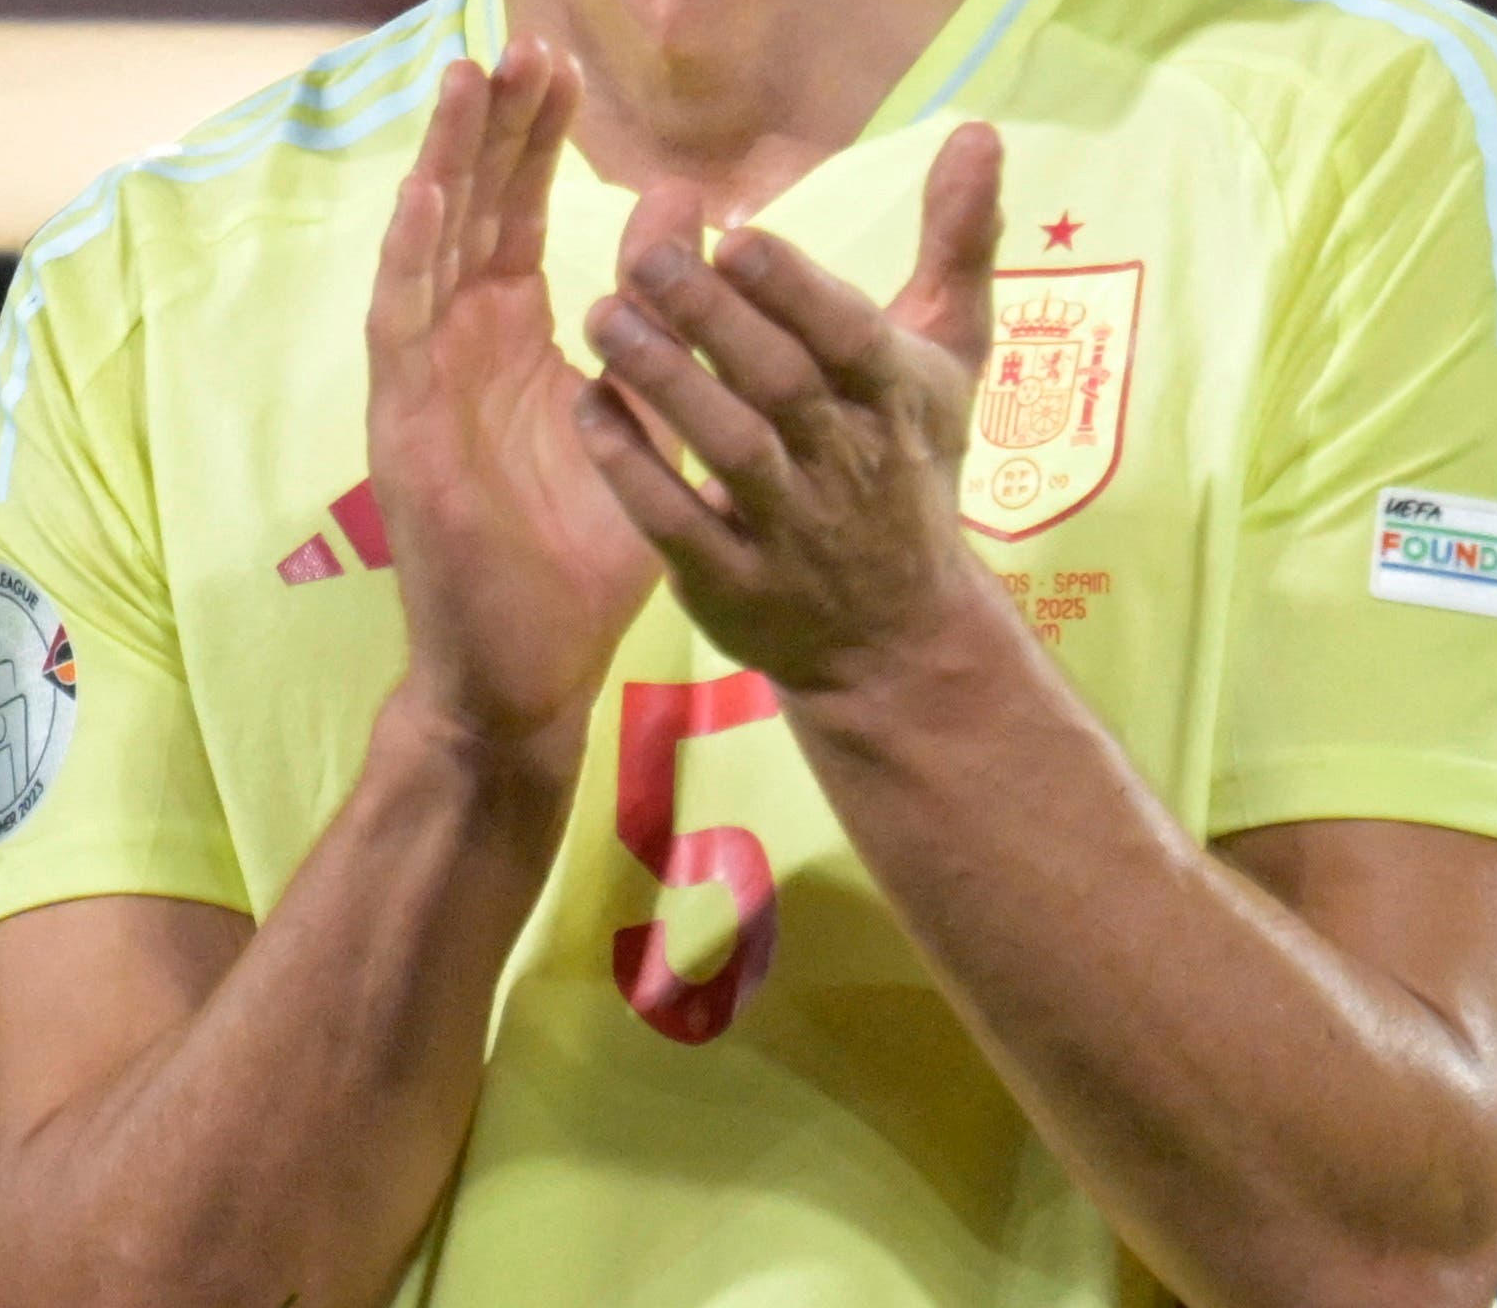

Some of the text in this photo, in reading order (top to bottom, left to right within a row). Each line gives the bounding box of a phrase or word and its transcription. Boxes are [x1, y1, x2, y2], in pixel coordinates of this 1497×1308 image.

[1385, 497, 1442, 522] UEFA
[1036, 597, 1087, 621] 2025
[613, 669, 782, 1047] 5
